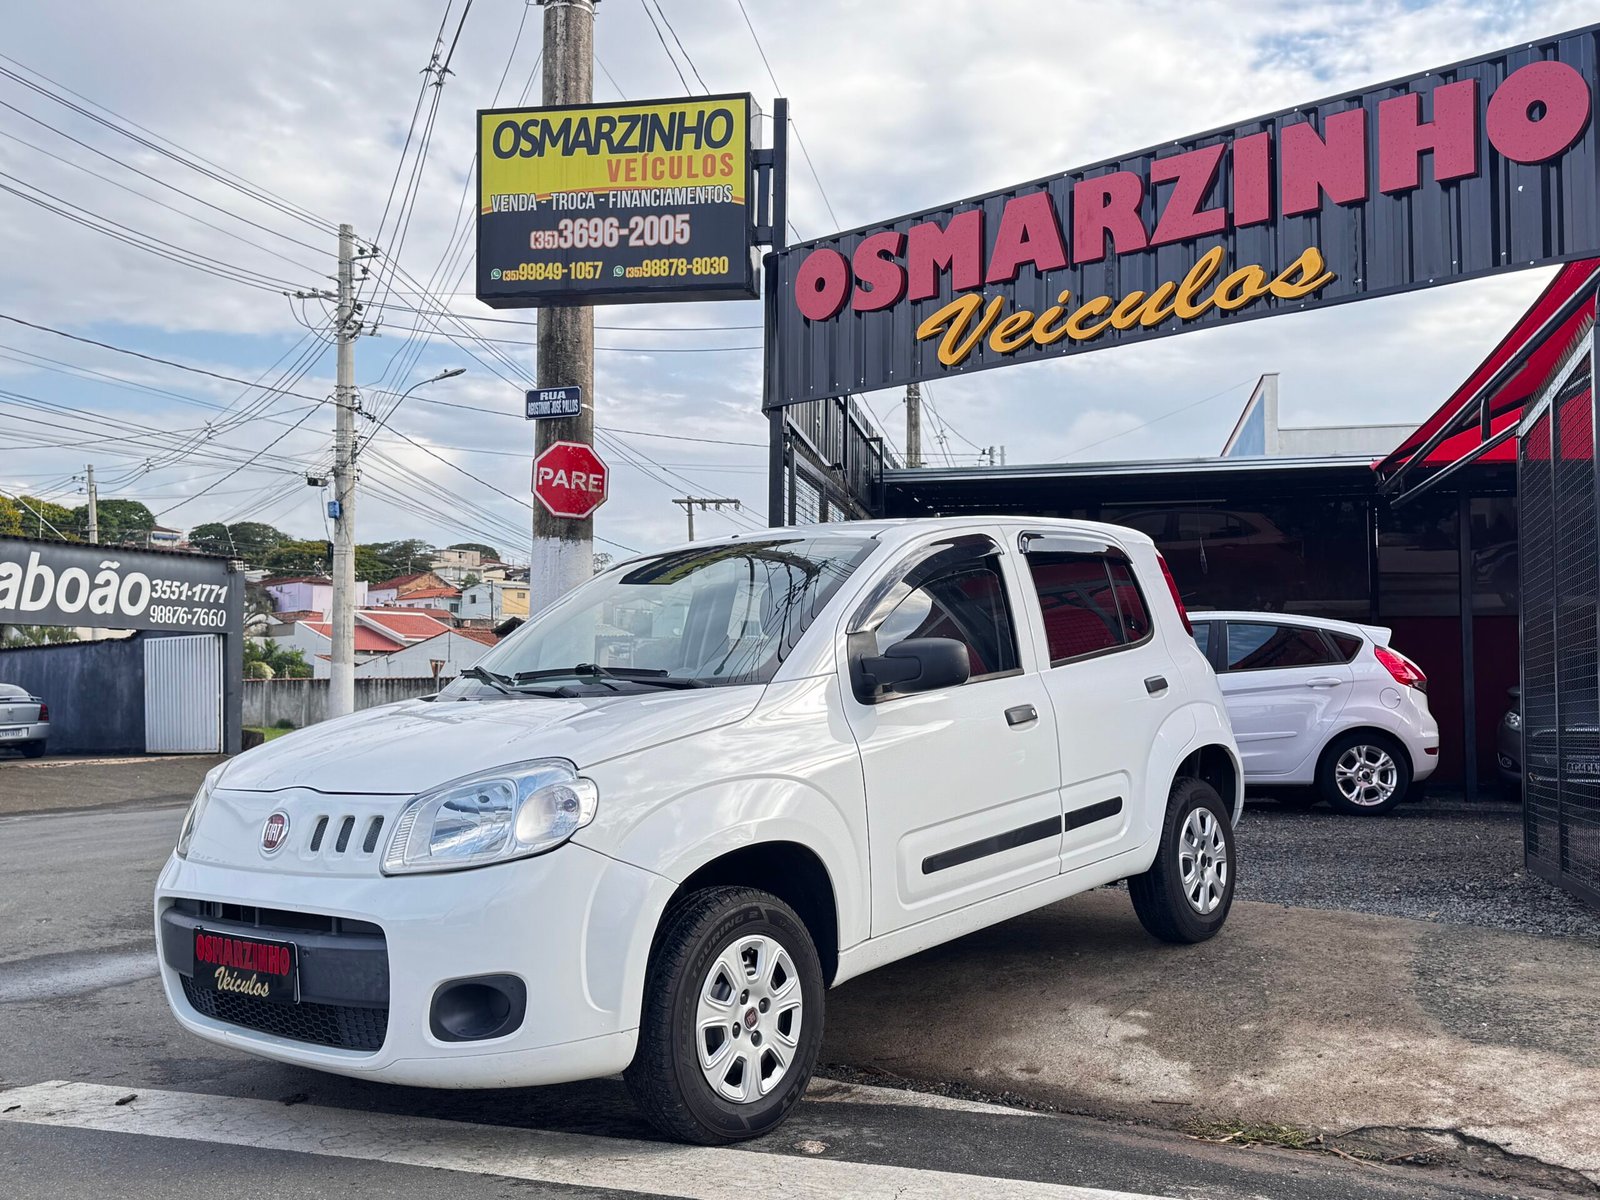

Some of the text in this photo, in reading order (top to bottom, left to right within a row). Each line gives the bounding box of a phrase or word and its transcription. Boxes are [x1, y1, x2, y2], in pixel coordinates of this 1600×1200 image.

[492, 109, 734, 159] OSMARZINHO
[607, 153, 735, 183] VEÍCULOS
[491, 193, 537, 213] VENDA
[551, 191, 596, 210] TROCA
[608, 184, 733, 209] FINANCIAMENTOS
[795, 60, 1591, 321] OSMARZINHO
[916, 246, 1335, 366] Veiculos
[540, 391, 566, 400] RUA
[537, 467, 603, 493] PARE
[265, 824, 283, 841] FIAT
[196, 934, 290, 976] OSMARZINHO
[691, 912, 745, 979] TOURING
